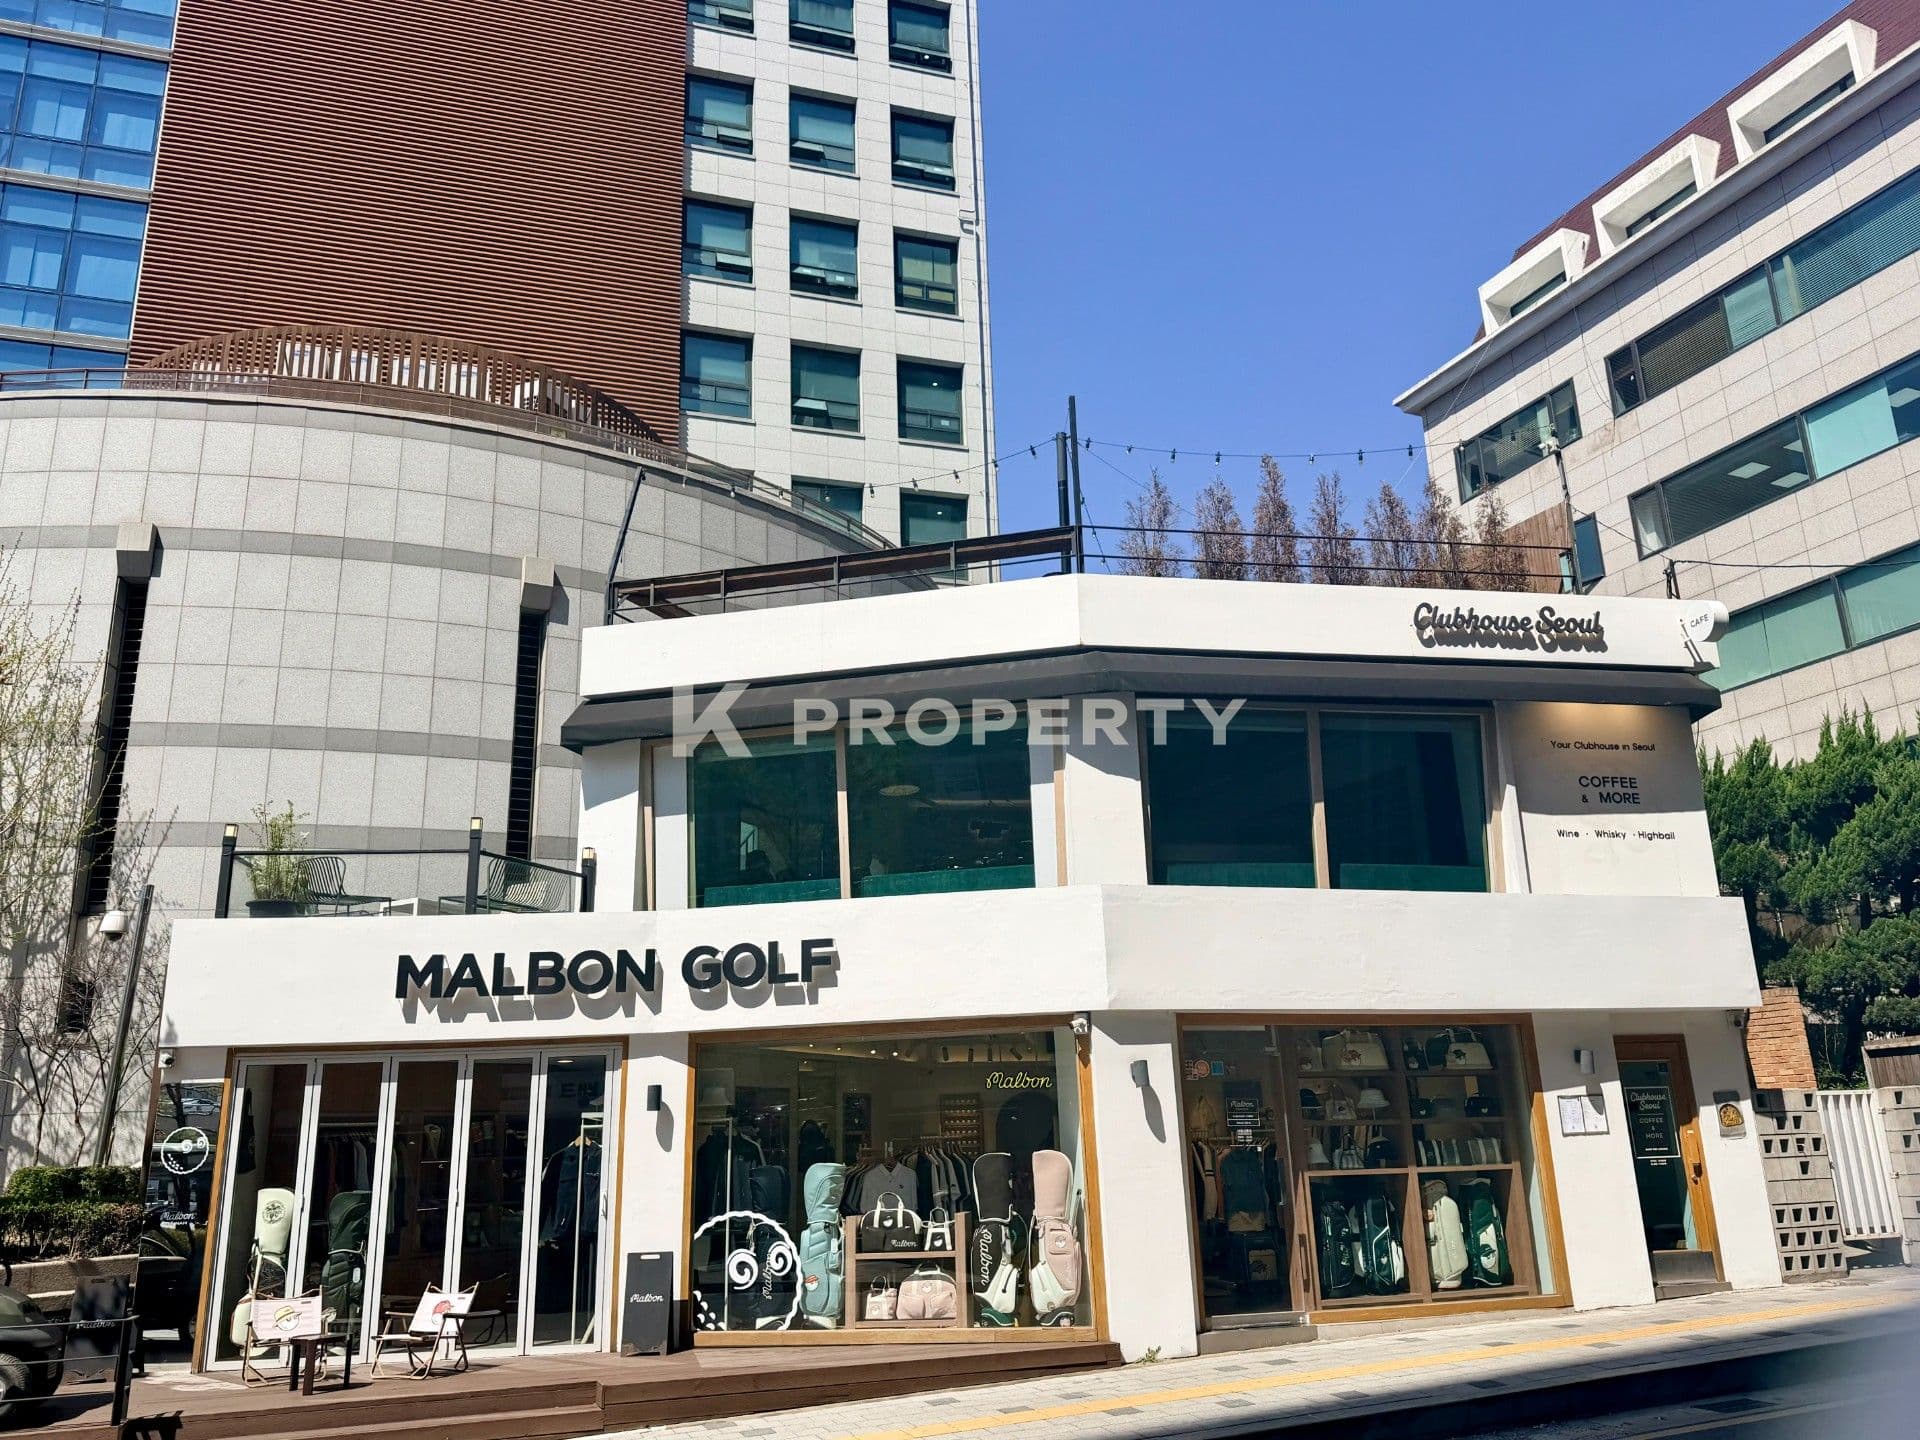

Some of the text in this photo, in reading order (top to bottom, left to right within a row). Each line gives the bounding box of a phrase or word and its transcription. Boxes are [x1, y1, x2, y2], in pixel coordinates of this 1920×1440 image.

[1413, 602, 1604, 634] Clubhouse Seoul
[1690, 613, 1710, 628] CAFE
[1550, 740, 1571, 749] Your
[1573, 741, 1619, 750] Clubhouse
[1632, 743, 1656, 751] Seoul
[1578, 775, 1638, 789] COFFEE
[1581, 792, 1641, 804] & MORE
[1556, 829, 1676, 841] Wine Whisky Highball
[395, 938, 834, 999] MALBON GOLF
[986, 1072, 1053, 1088] Malbon
[979, 1224, 993, 1286] Malbon
[630, 1293, 664, 1303] Malbon
